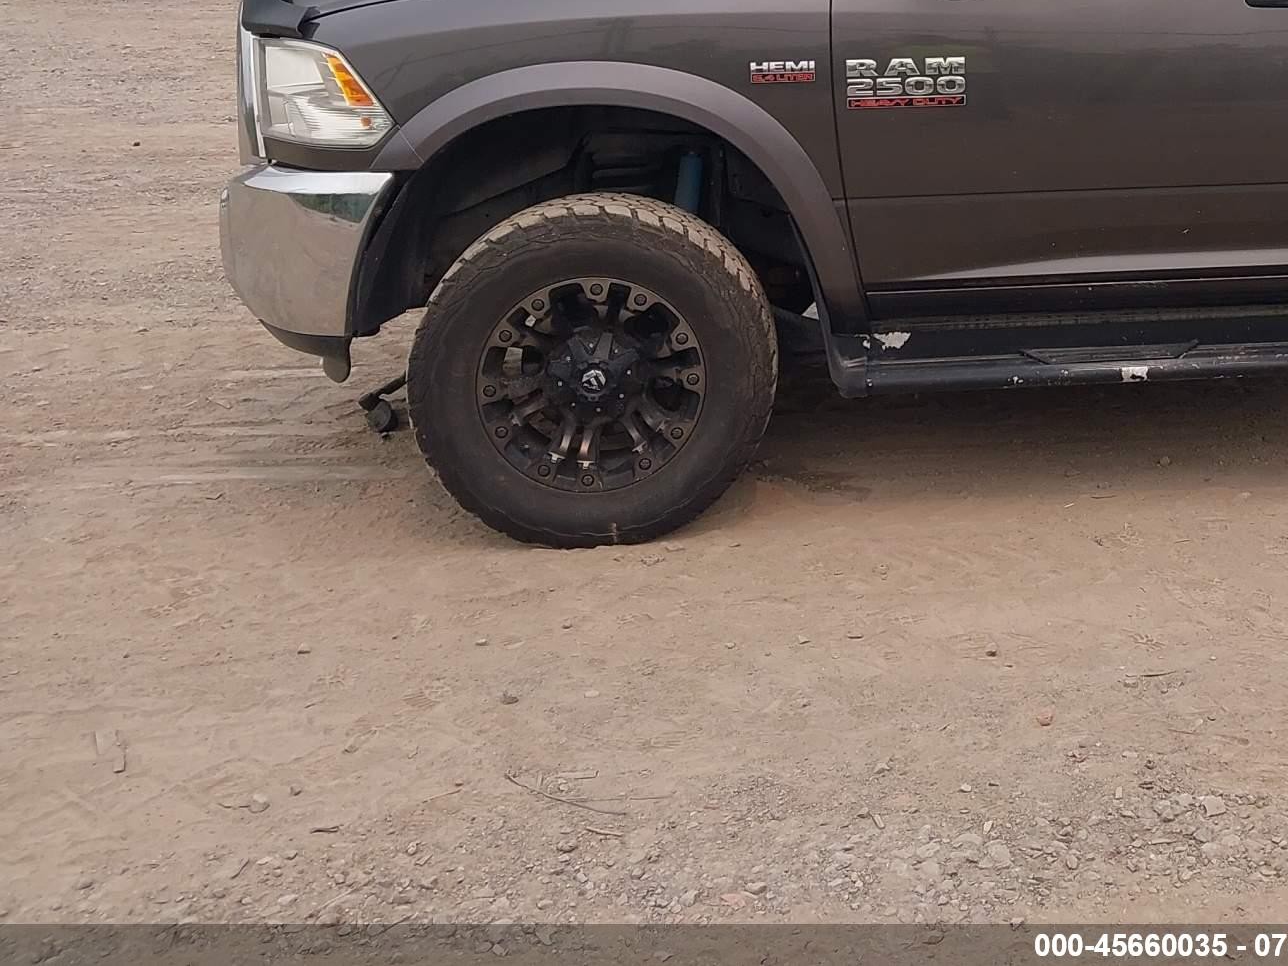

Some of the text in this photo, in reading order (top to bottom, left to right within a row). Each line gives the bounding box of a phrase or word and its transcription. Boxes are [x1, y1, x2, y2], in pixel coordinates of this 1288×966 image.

[750, 60, 816, 72] HEMI
[845, 56, 966, 77] RAM
[776, 73, 813, 81] LITER
[846, 75, 967, 97] 2500
[850, 96, 962, 107] HEAVY DUTY
